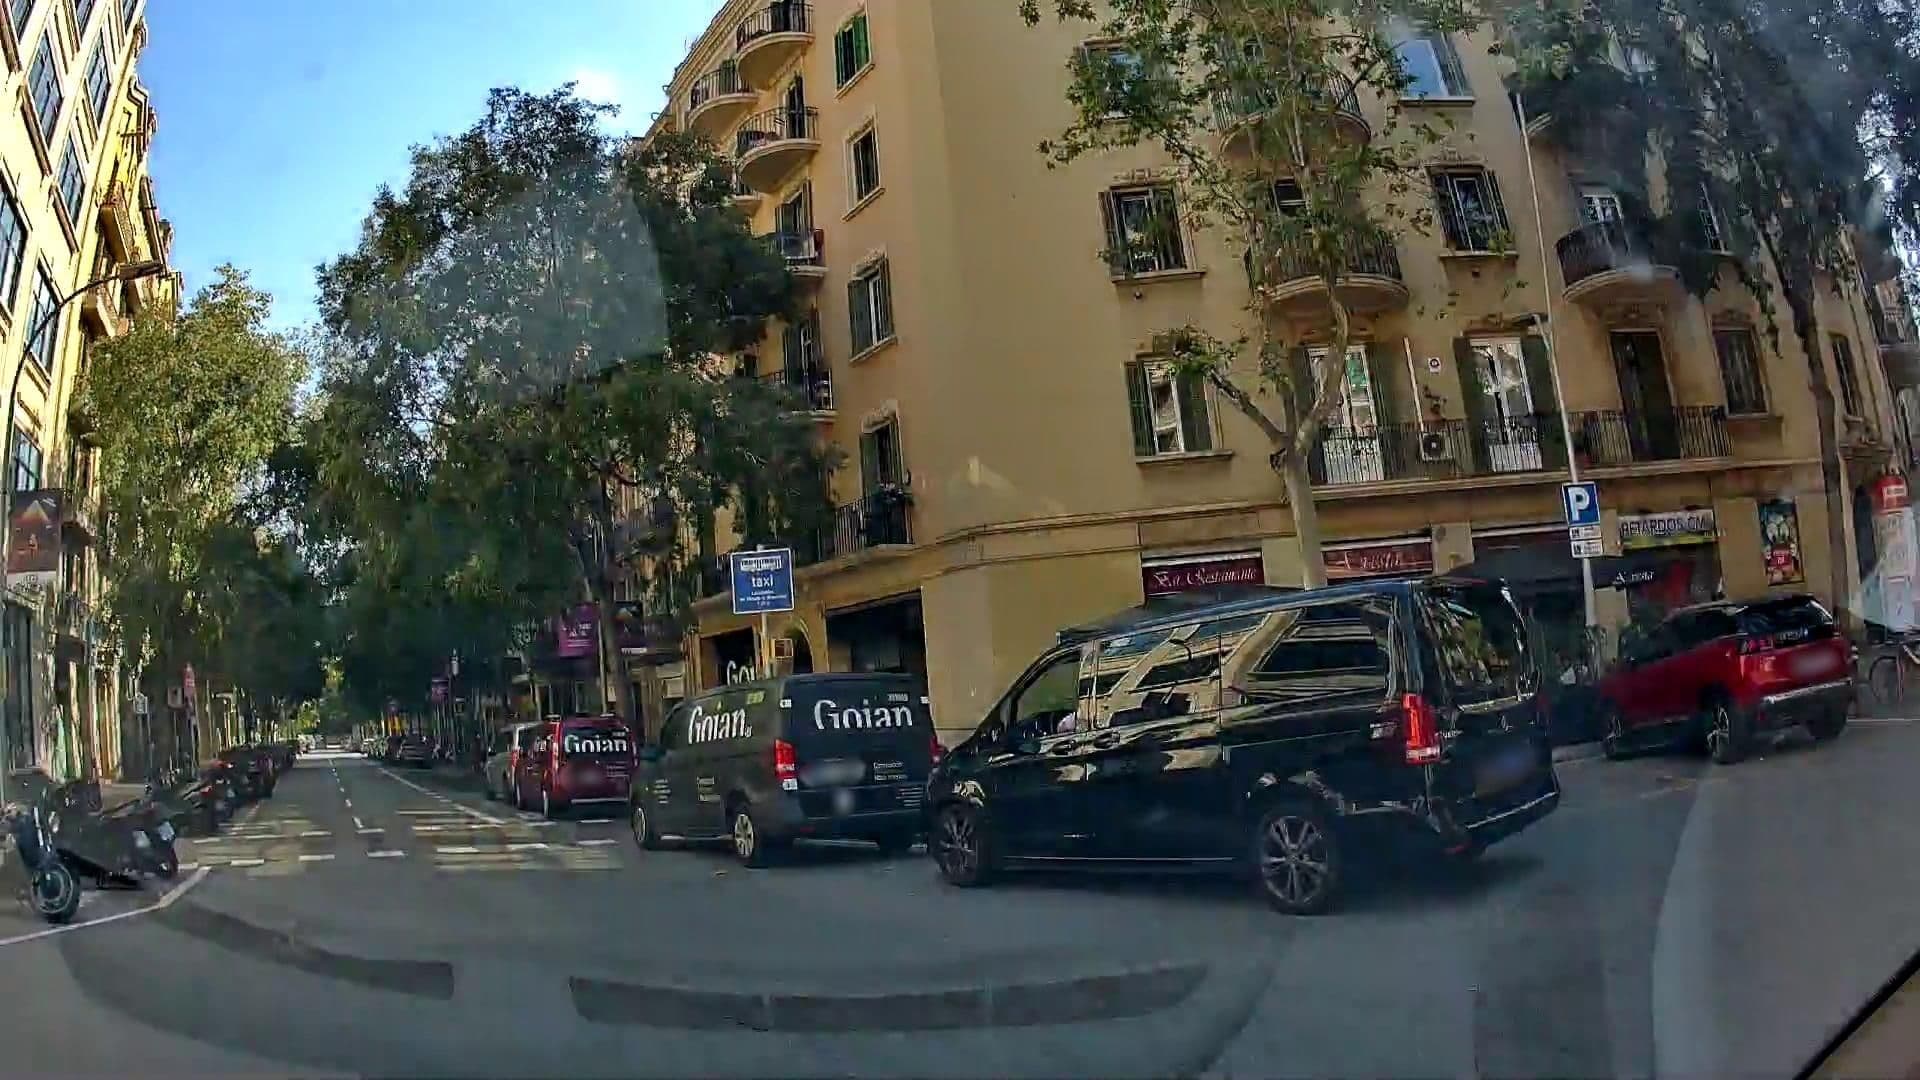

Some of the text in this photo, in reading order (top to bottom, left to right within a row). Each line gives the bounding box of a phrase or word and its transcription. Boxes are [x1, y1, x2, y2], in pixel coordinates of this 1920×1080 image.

[1568, 487, 1589, 520] P
[688, 701, 746, 745] Goian
[814, 699, 914, 730] Goian
[564, 733, 628, 753] Goian
